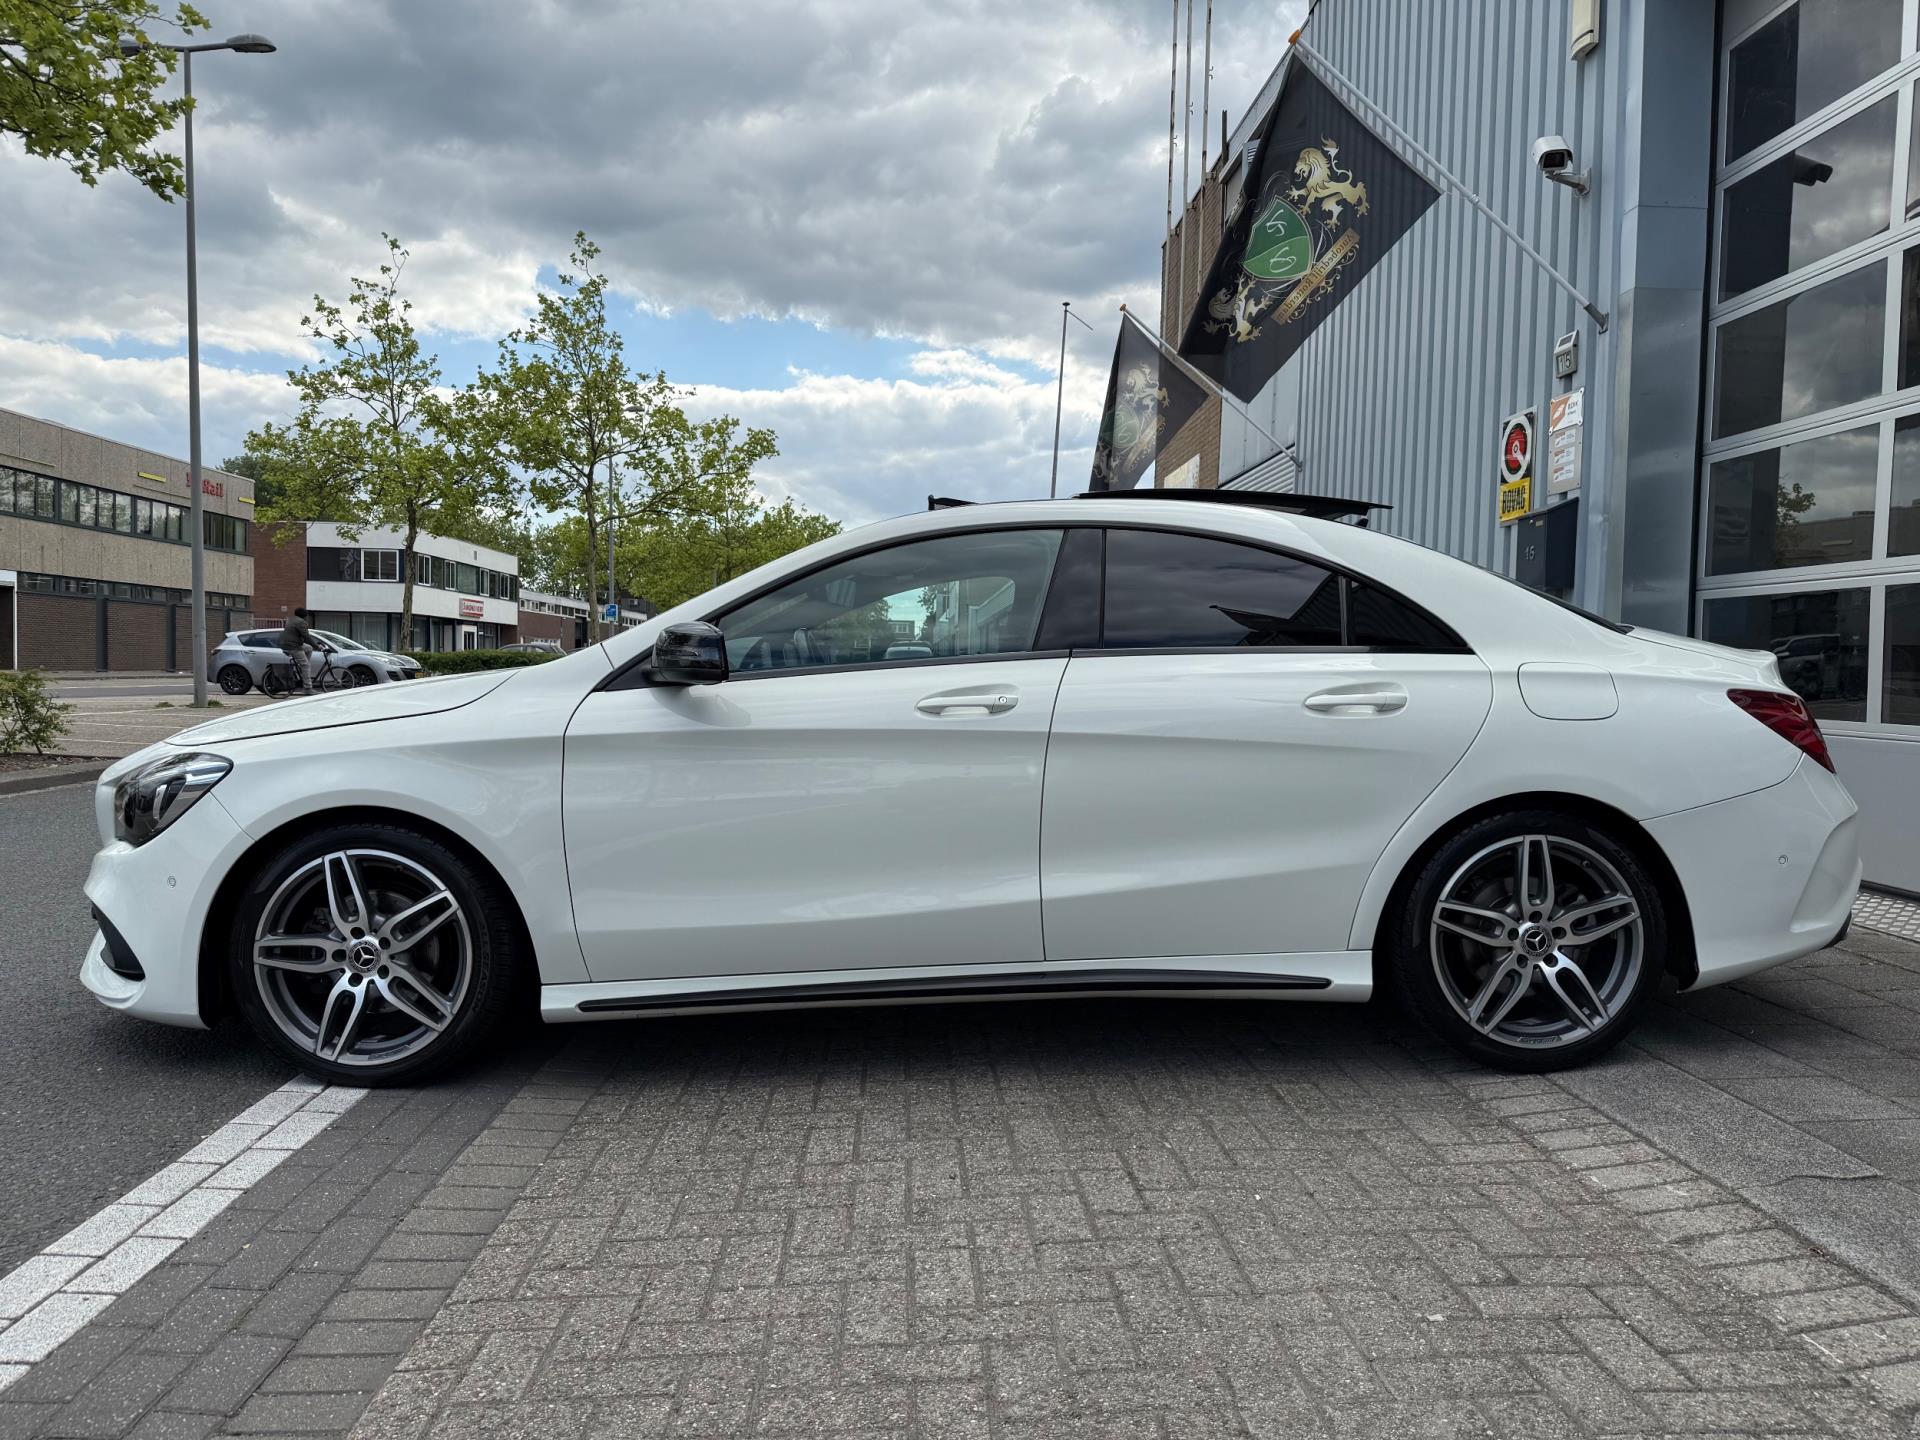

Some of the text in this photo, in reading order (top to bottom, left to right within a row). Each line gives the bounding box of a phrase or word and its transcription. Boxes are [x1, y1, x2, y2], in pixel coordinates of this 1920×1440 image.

[1559, 352, 1571, 373] 15
[1502, 486, 1526, 514] BOVAG
[1525, 545, 1535, 560] 15
